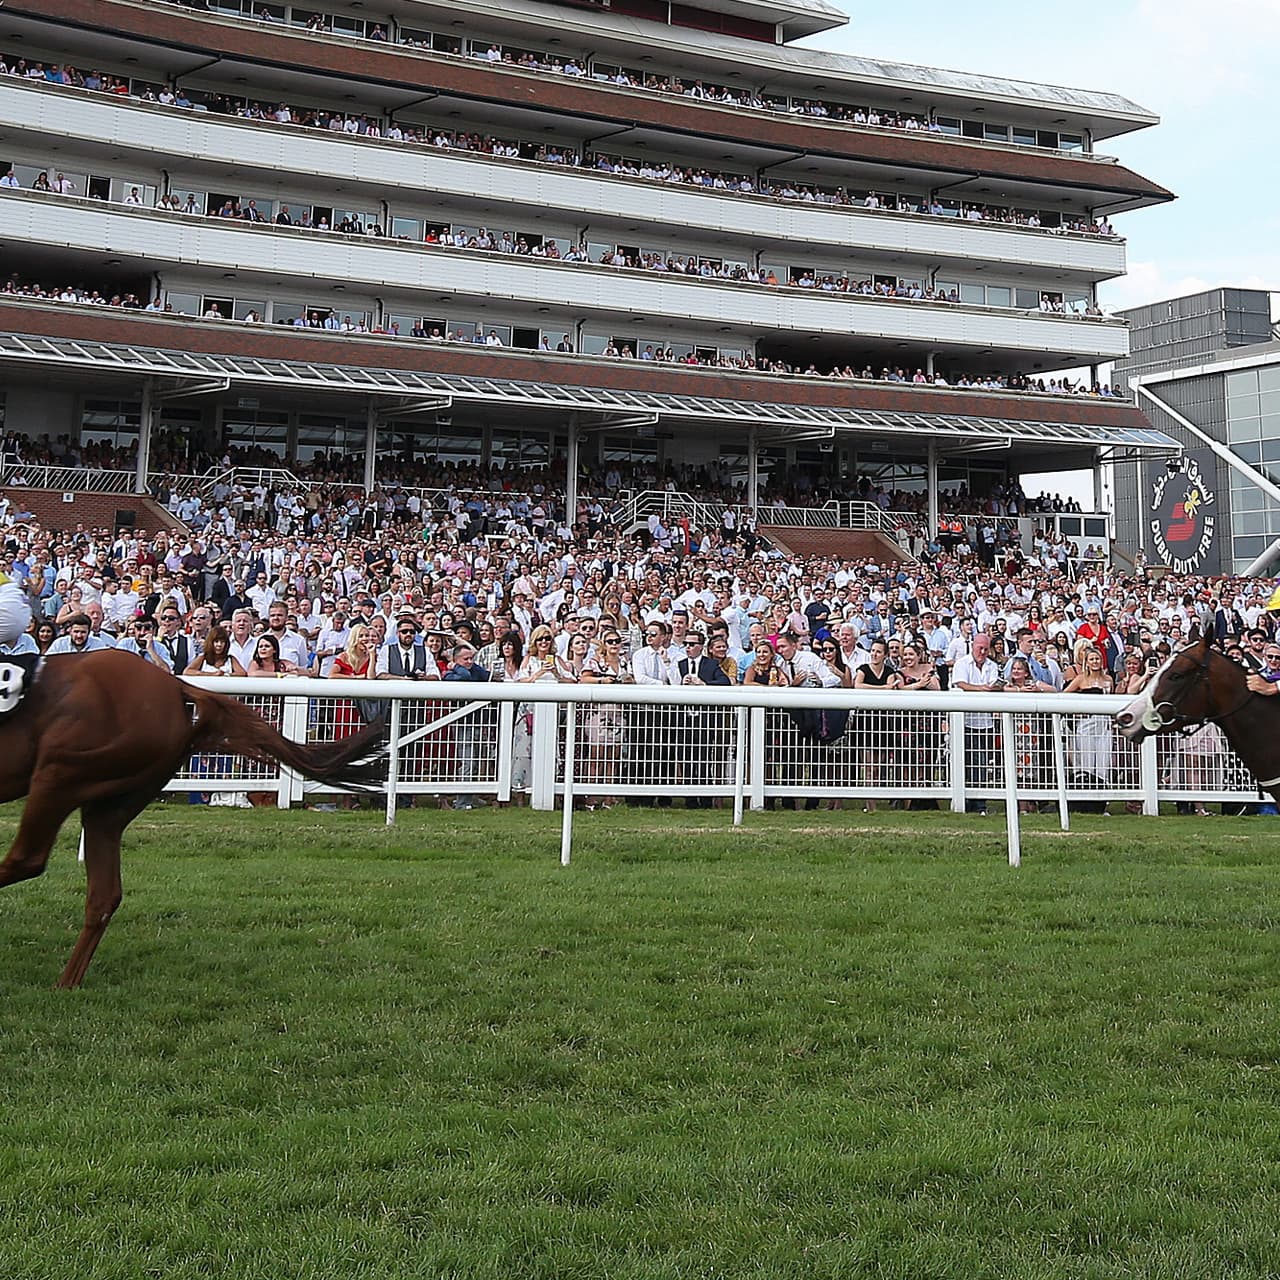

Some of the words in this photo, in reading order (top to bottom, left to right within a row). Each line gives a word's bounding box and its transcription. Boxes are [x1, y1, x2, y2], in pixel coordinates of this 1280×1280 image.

[1151, 519, 1173, 566] DUBAI
[1173, 552, 1200, 575] DUTY
[1199, 516, 1214, 559] FREE
